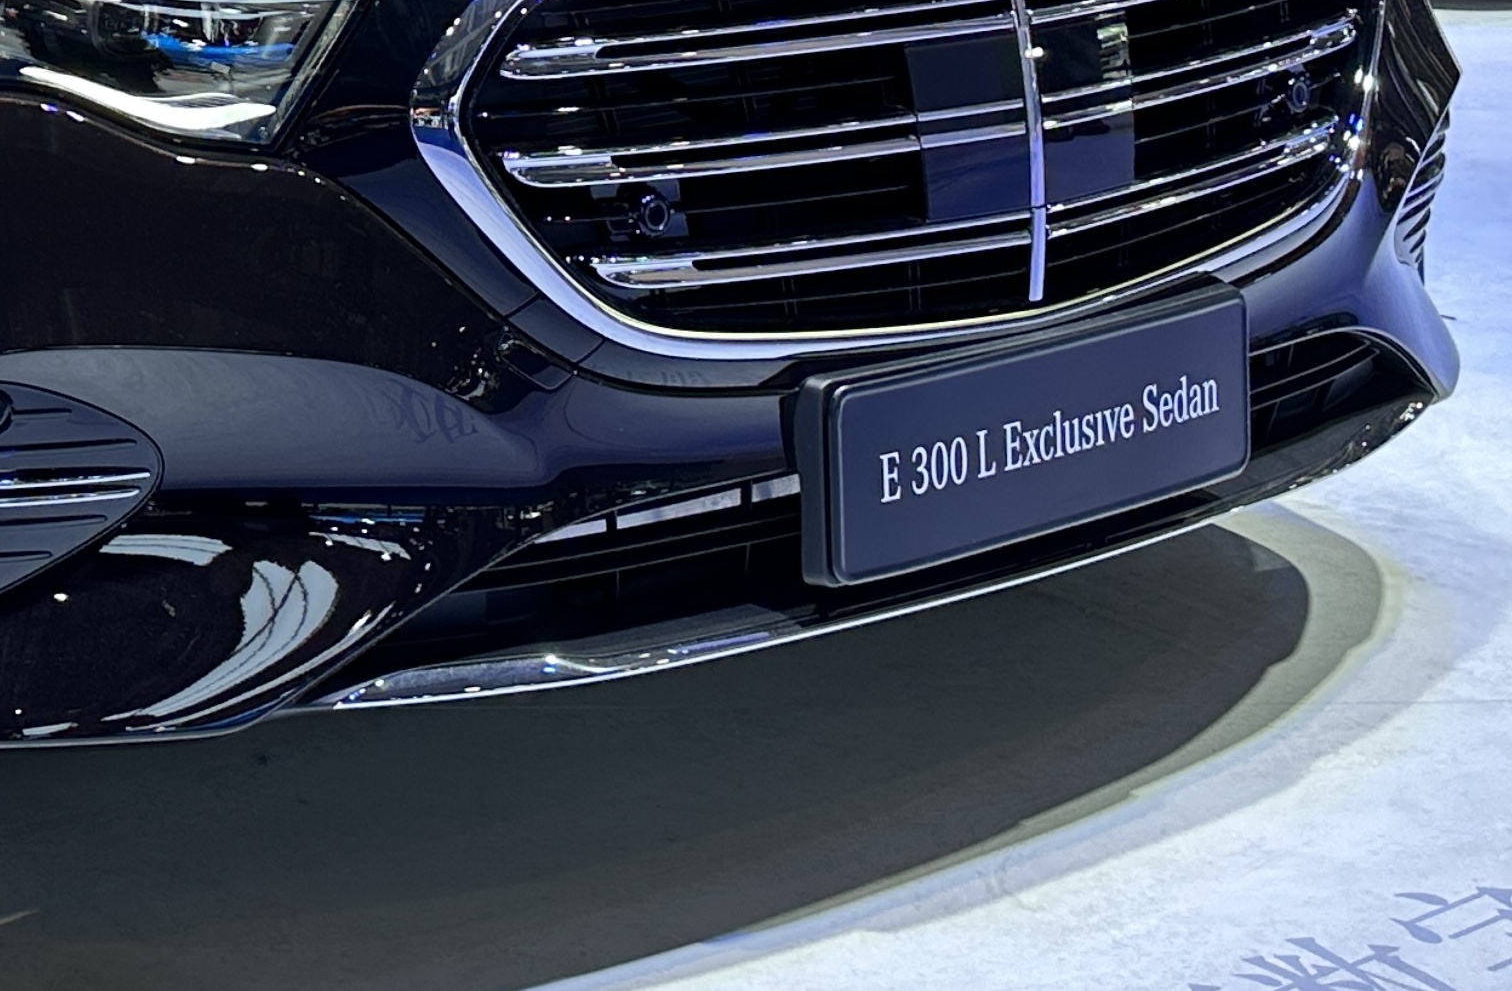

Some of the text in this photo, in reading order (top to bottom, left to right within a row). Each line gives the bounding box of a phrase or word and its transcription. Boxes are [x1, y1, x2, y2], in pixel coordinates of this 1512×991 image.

[879, 375, 1220, 504] E 300 L Exclusive Sedan
